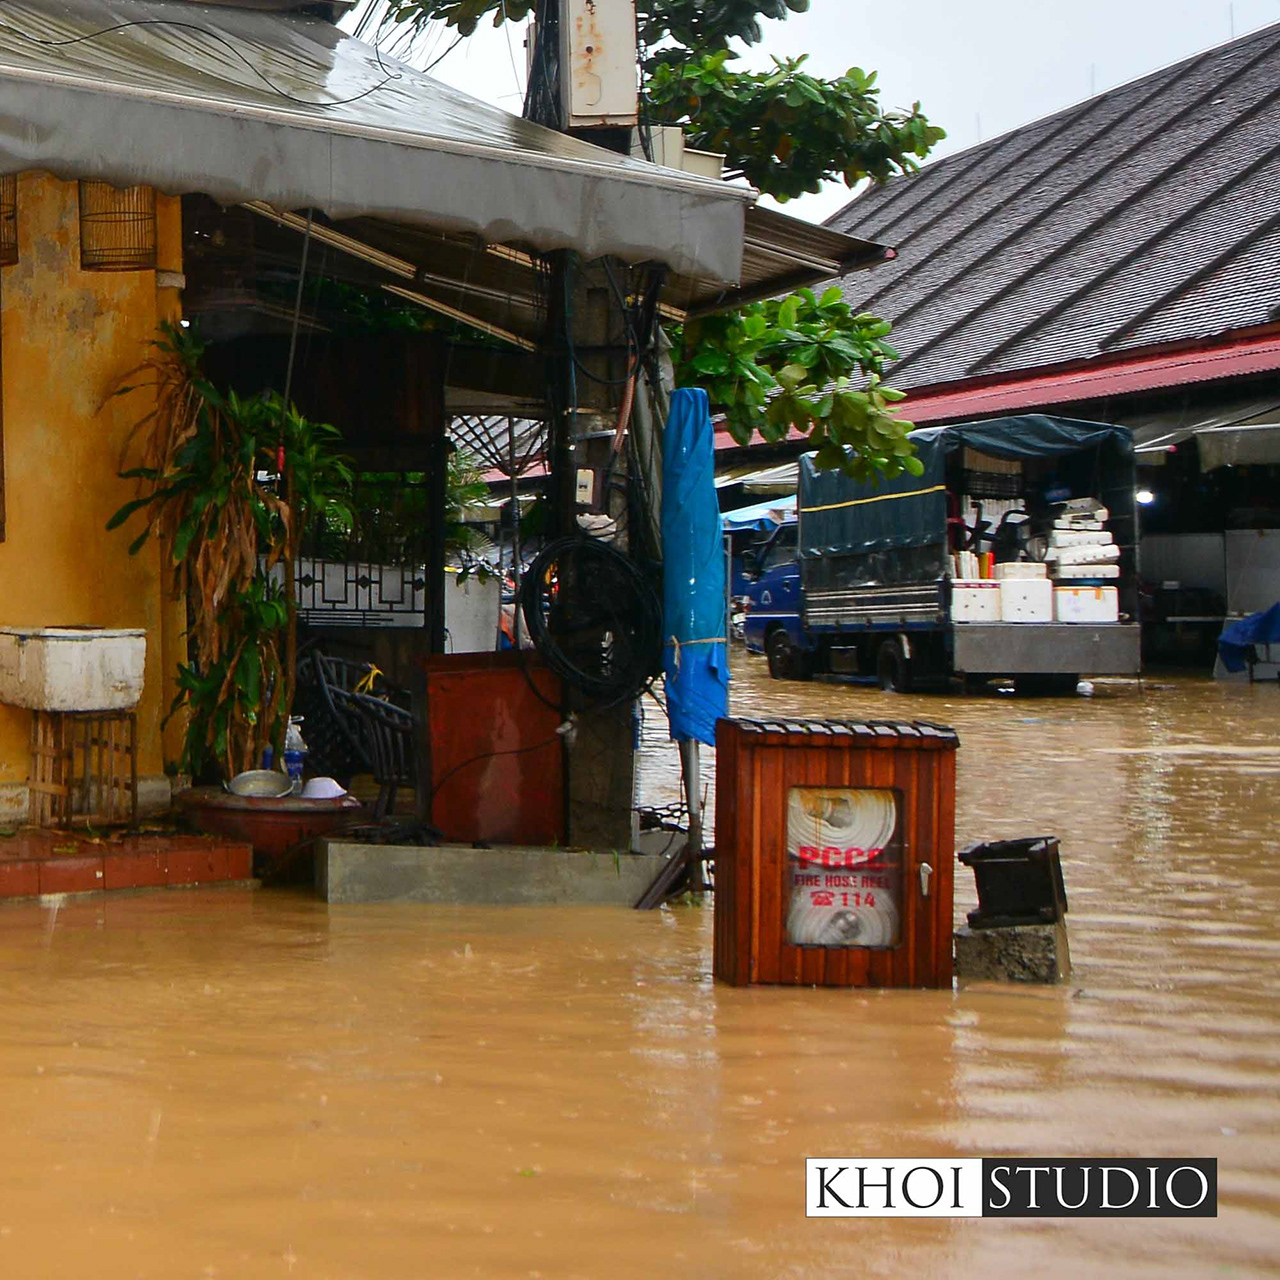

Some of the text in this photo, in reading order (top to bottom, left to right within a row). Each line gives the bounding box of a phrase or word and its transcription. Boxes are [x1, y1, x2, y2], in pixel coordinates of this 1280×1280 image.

[799, 846, 888, 871] PCCC
[795, 874, 890, 889] FIRE HOSE REEL
[840, 892, 875, 907] 114
